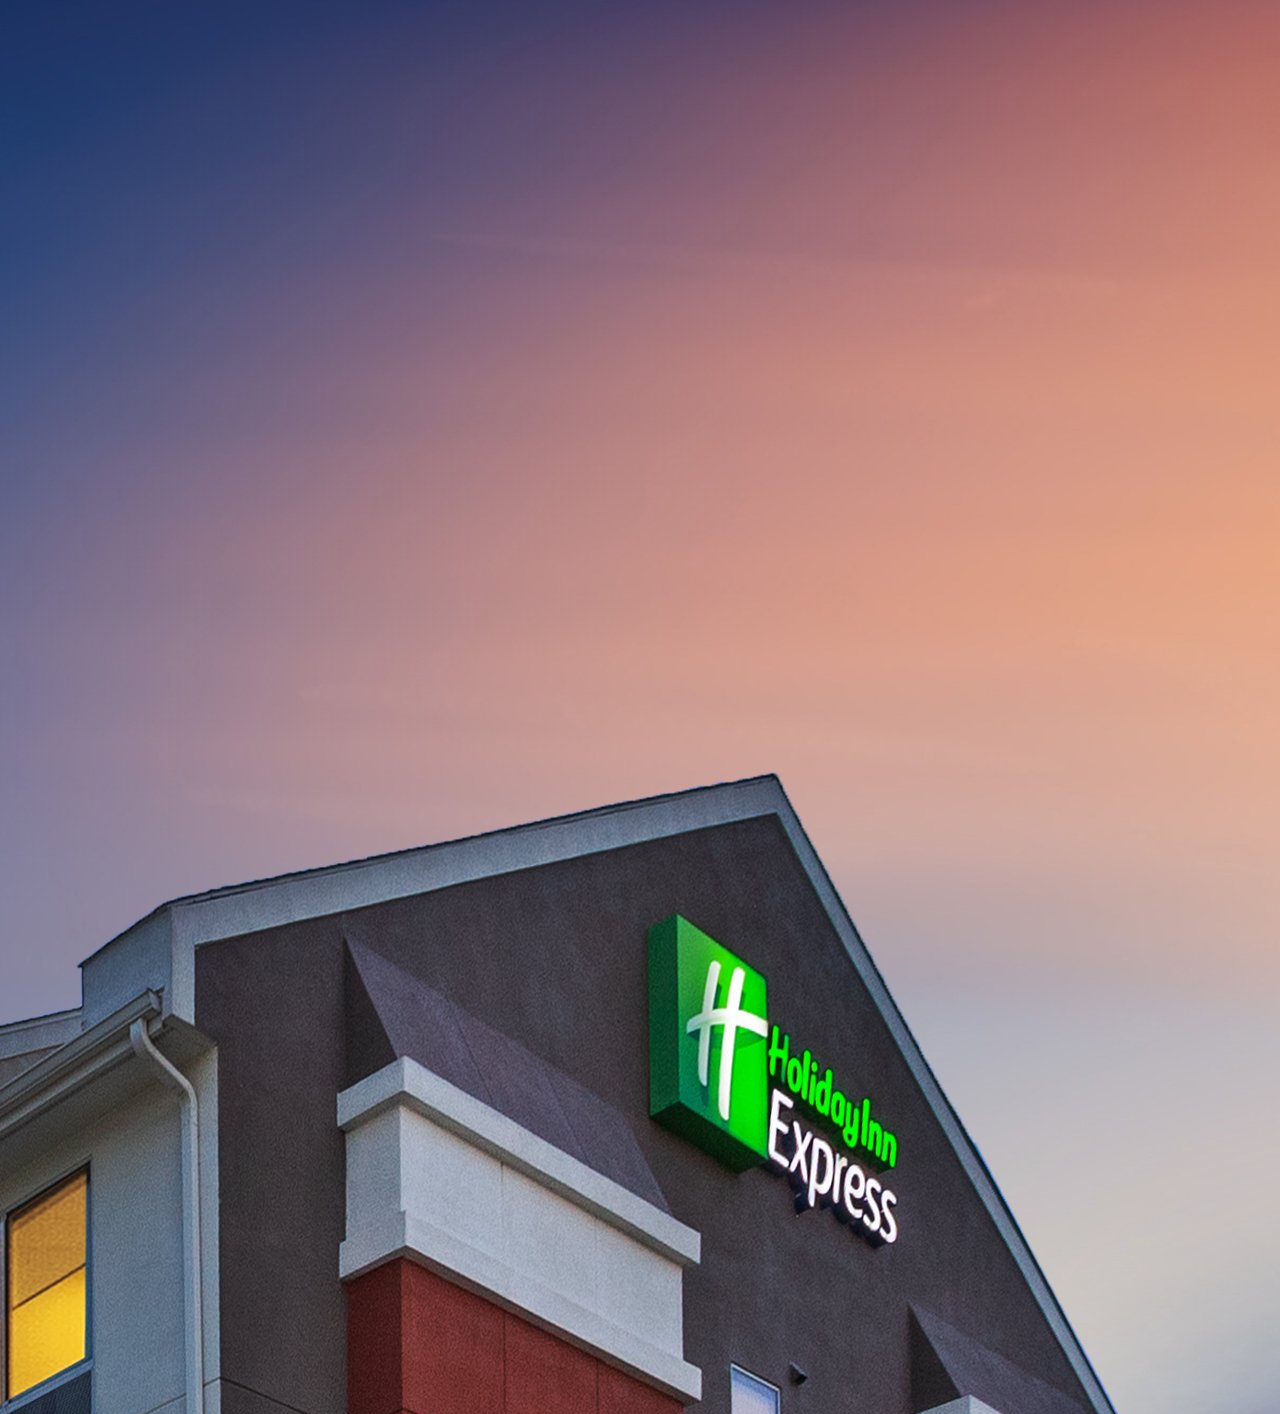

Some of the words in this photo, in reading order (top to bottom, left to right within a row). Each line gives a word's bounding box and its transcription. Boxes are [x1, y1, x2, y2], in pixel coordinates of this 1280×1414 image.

[686, 960, 768, 1121] H
[768, 1025, 860, 1148] Holiday
[861, 1098, 897, 1168] Inn
[768, 1088, 898, 1244] Express
